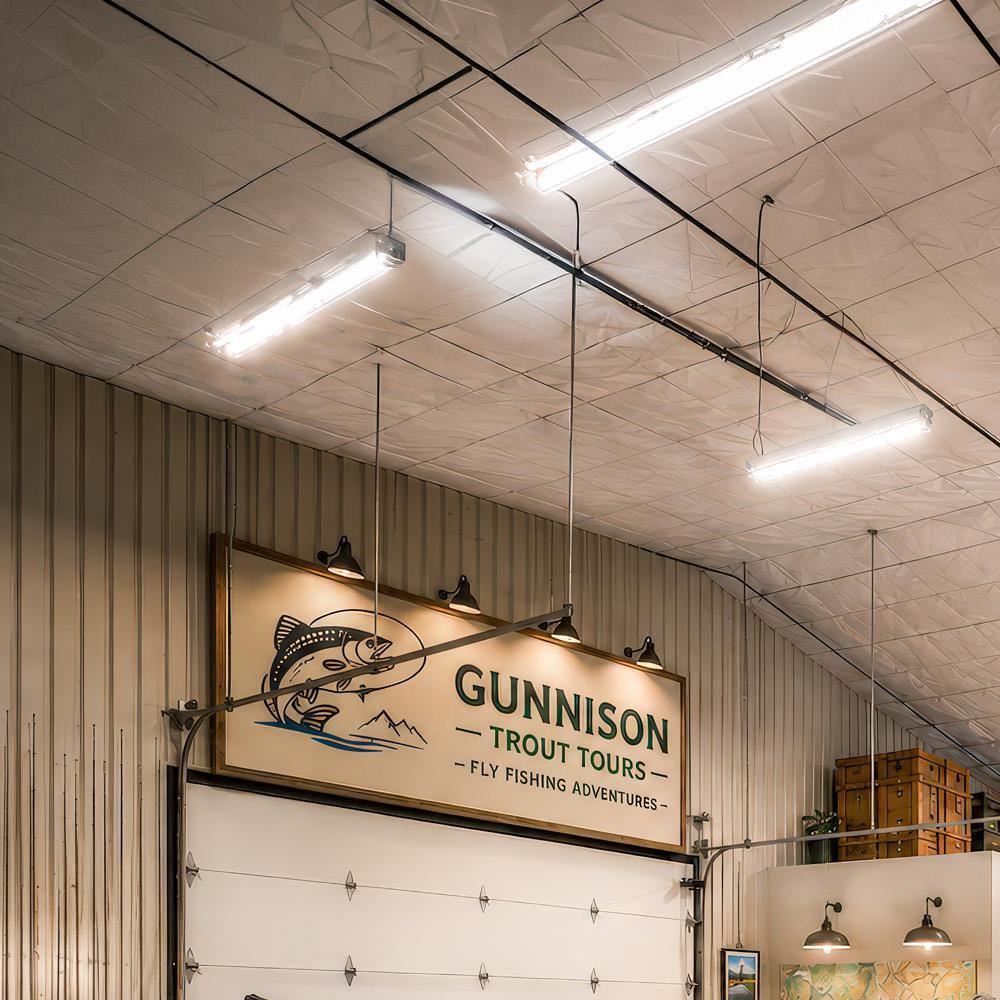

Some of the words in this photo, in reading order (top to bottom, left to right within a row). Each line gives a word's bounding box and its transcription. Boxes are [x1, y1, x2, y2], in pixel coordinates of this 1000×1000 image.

[455, 664, 669, 754] GUNNISON
[489, 725, 570, 764] TROUT
[576, 746, 646, 781] TOURS
[470, 760, 499, 779] FLY
[505, 767, 566, 792] FISHING
[572, 781, 658, 811] ADVENTURES
